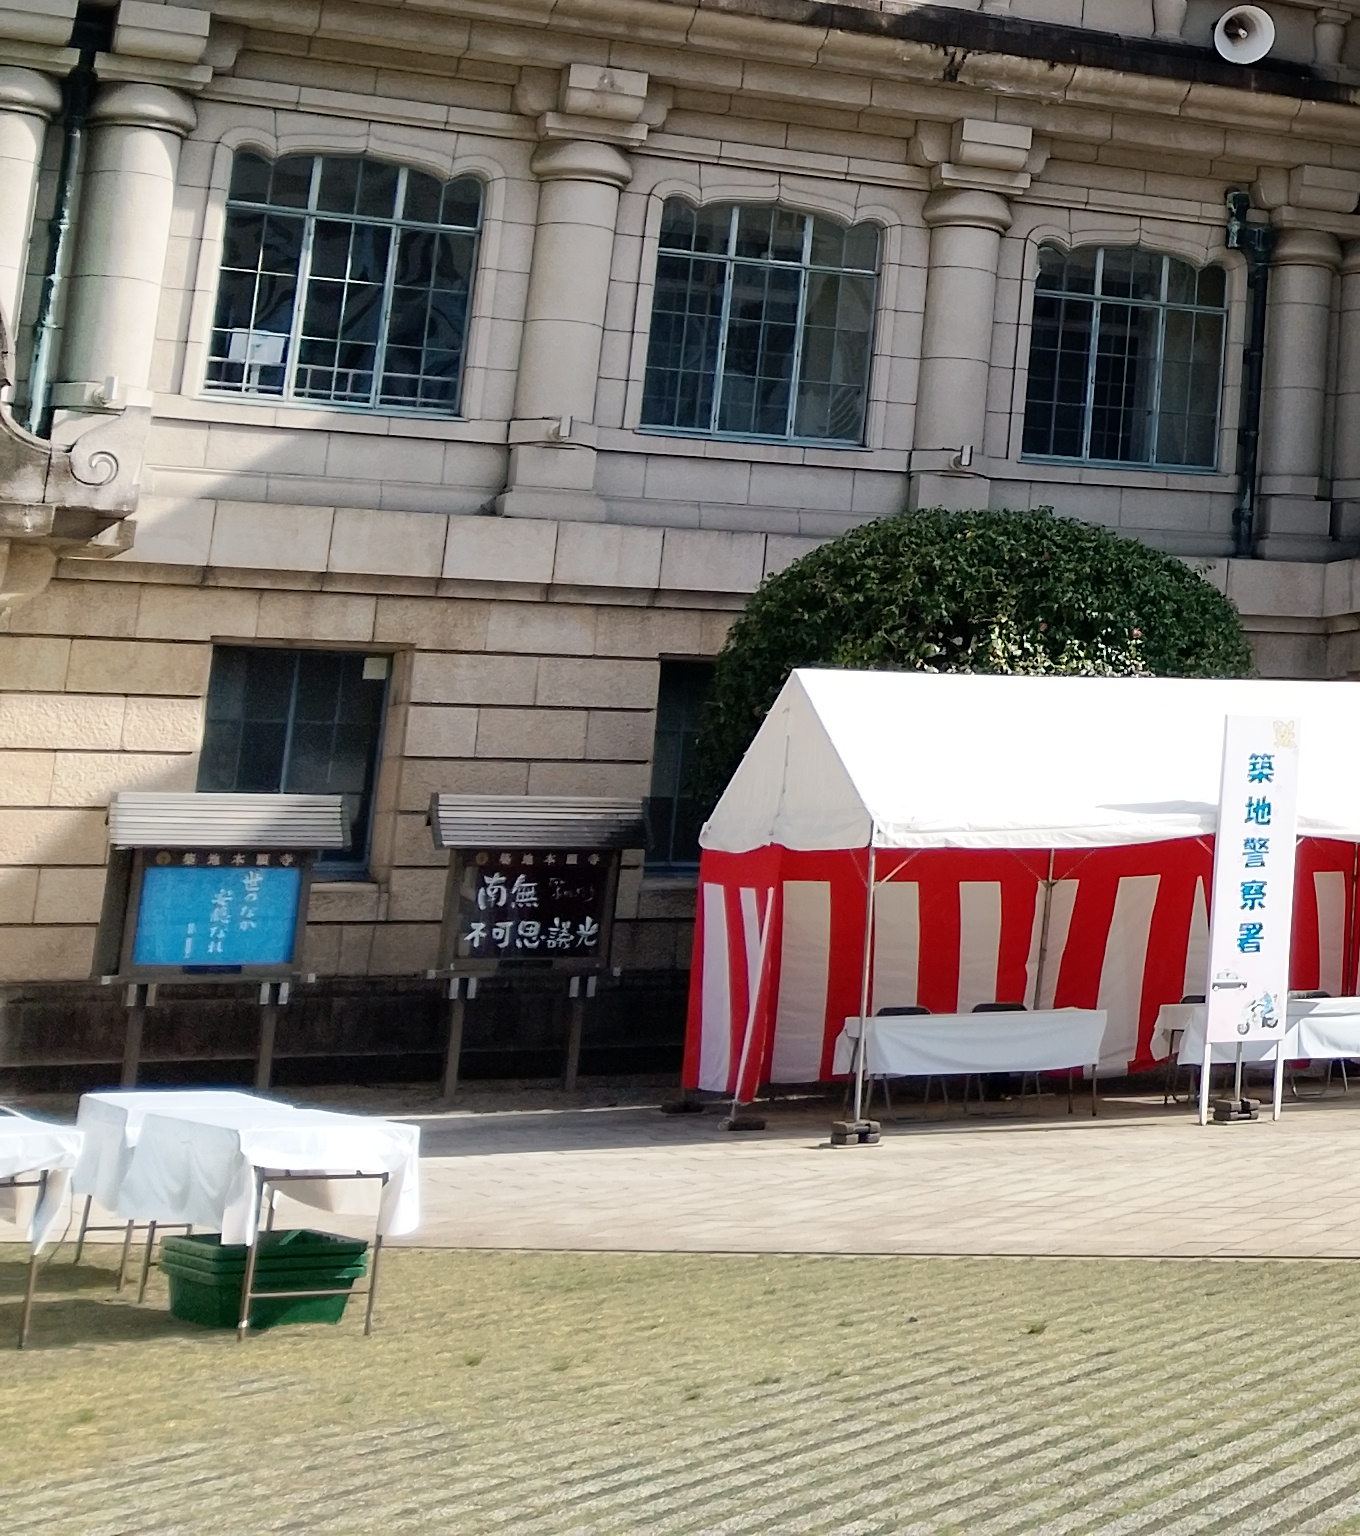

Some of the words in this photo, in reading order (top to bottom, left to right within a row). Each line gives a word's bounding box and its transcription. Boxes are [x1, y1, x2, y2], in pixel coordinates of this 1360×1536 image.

[1237, 752, 1275, 954] 築地警察署
[477, 871, 540, 911] 南無
[463, 915, 600, 950] 不可思議光
